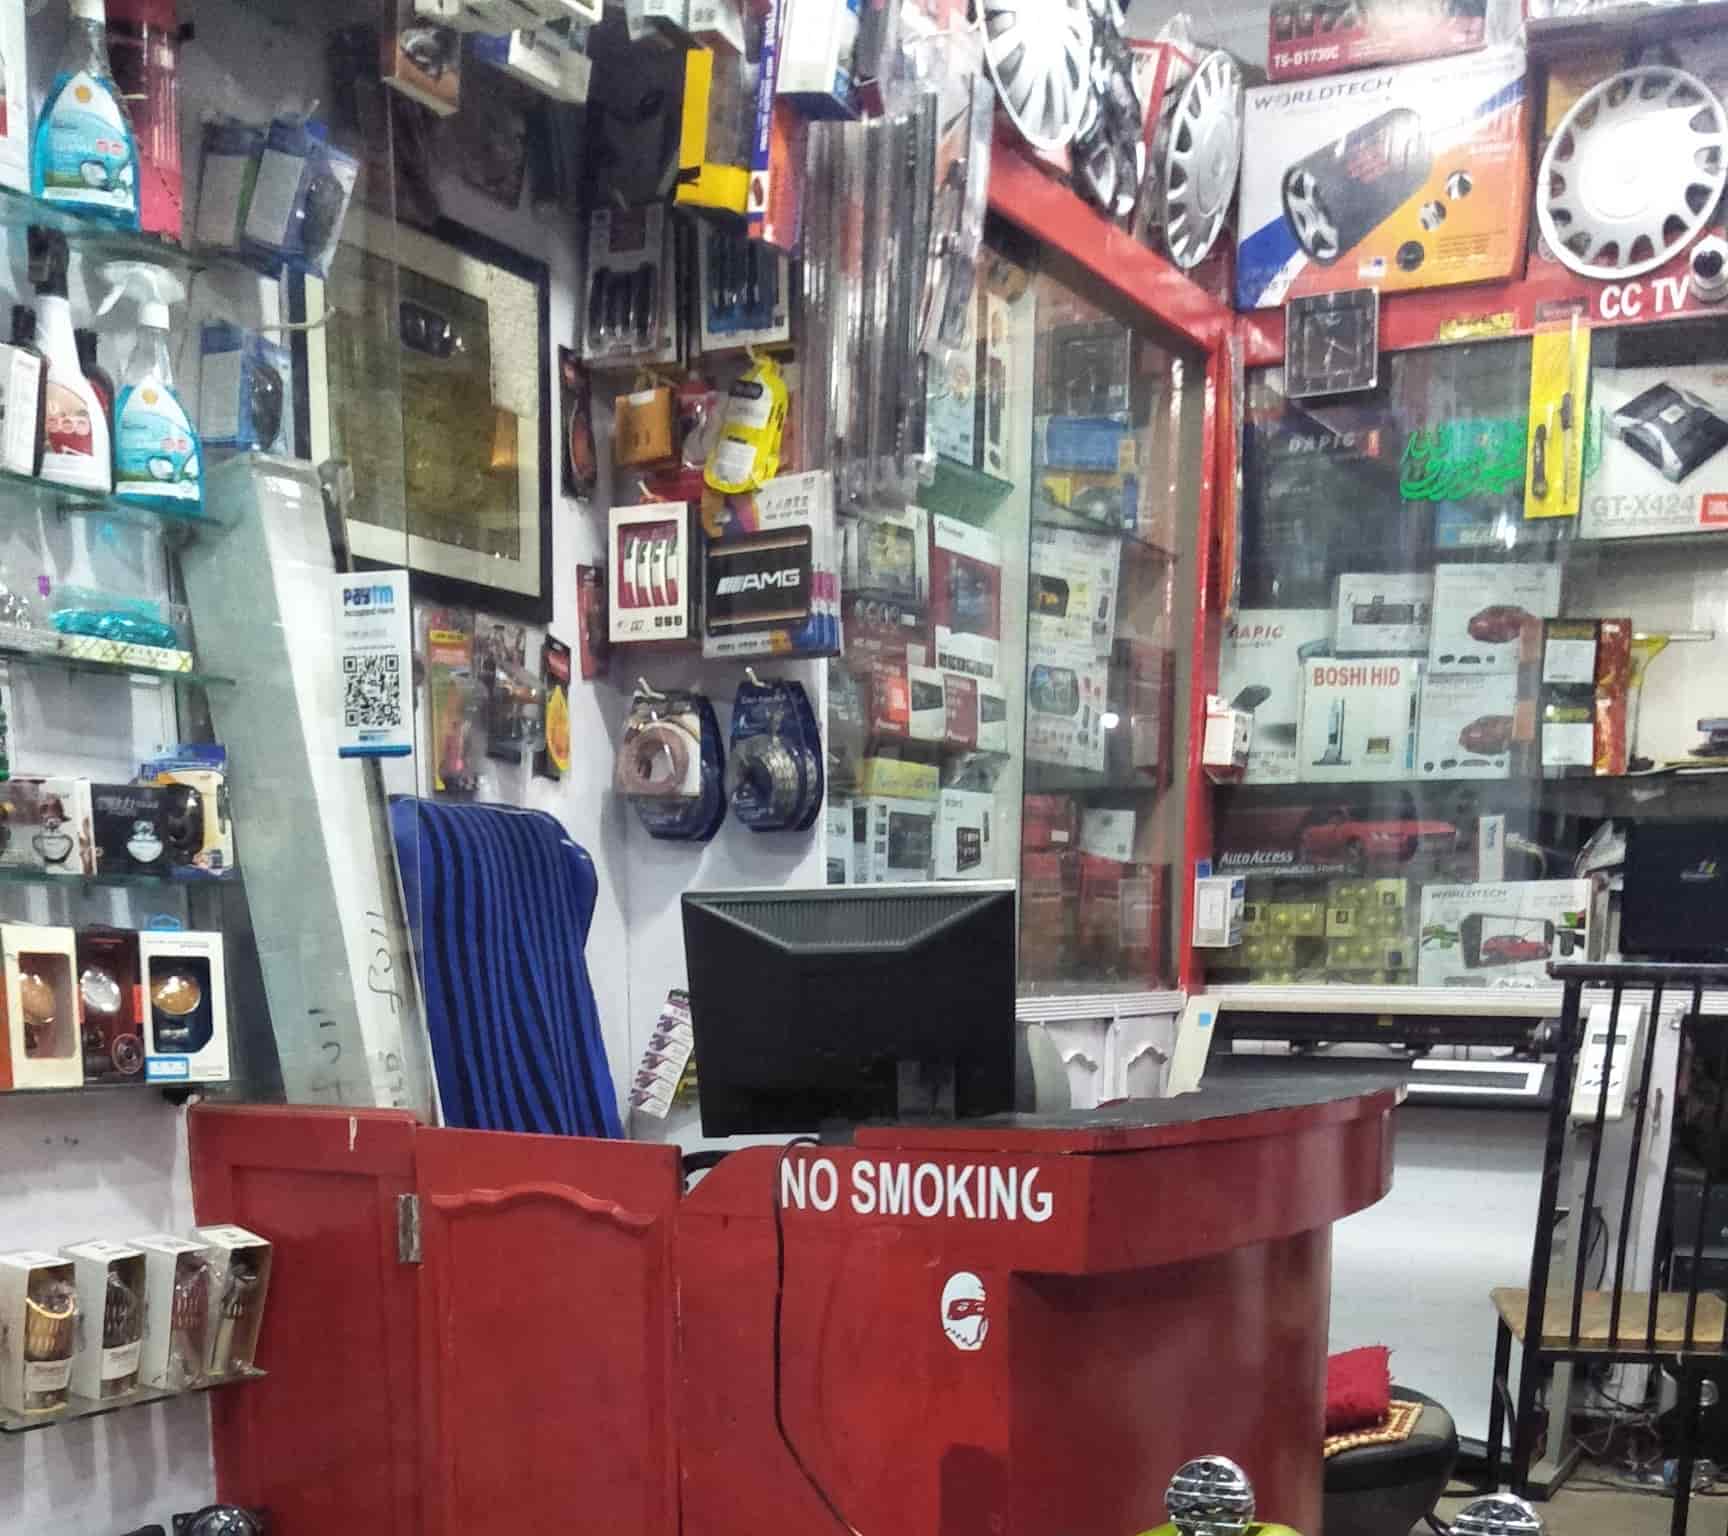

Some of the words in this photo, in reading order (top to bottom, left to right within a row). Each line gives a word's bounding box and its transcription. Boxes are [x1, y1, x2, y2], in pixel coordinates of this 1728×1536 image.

[1254, 77, 1393, 111] WORLDTECH
[1599, 283, 1642, 320] CC
[1650, 276, 1690, 313] TV
[743, 567, 801, 593] AMG
[1313, 666, 1367, 687] BOSHI
[1370, 665, 1400, 687] HID
[780, 1158, 840, 1212] NO
[850, 1160, 1054, 1223] SMOKING
